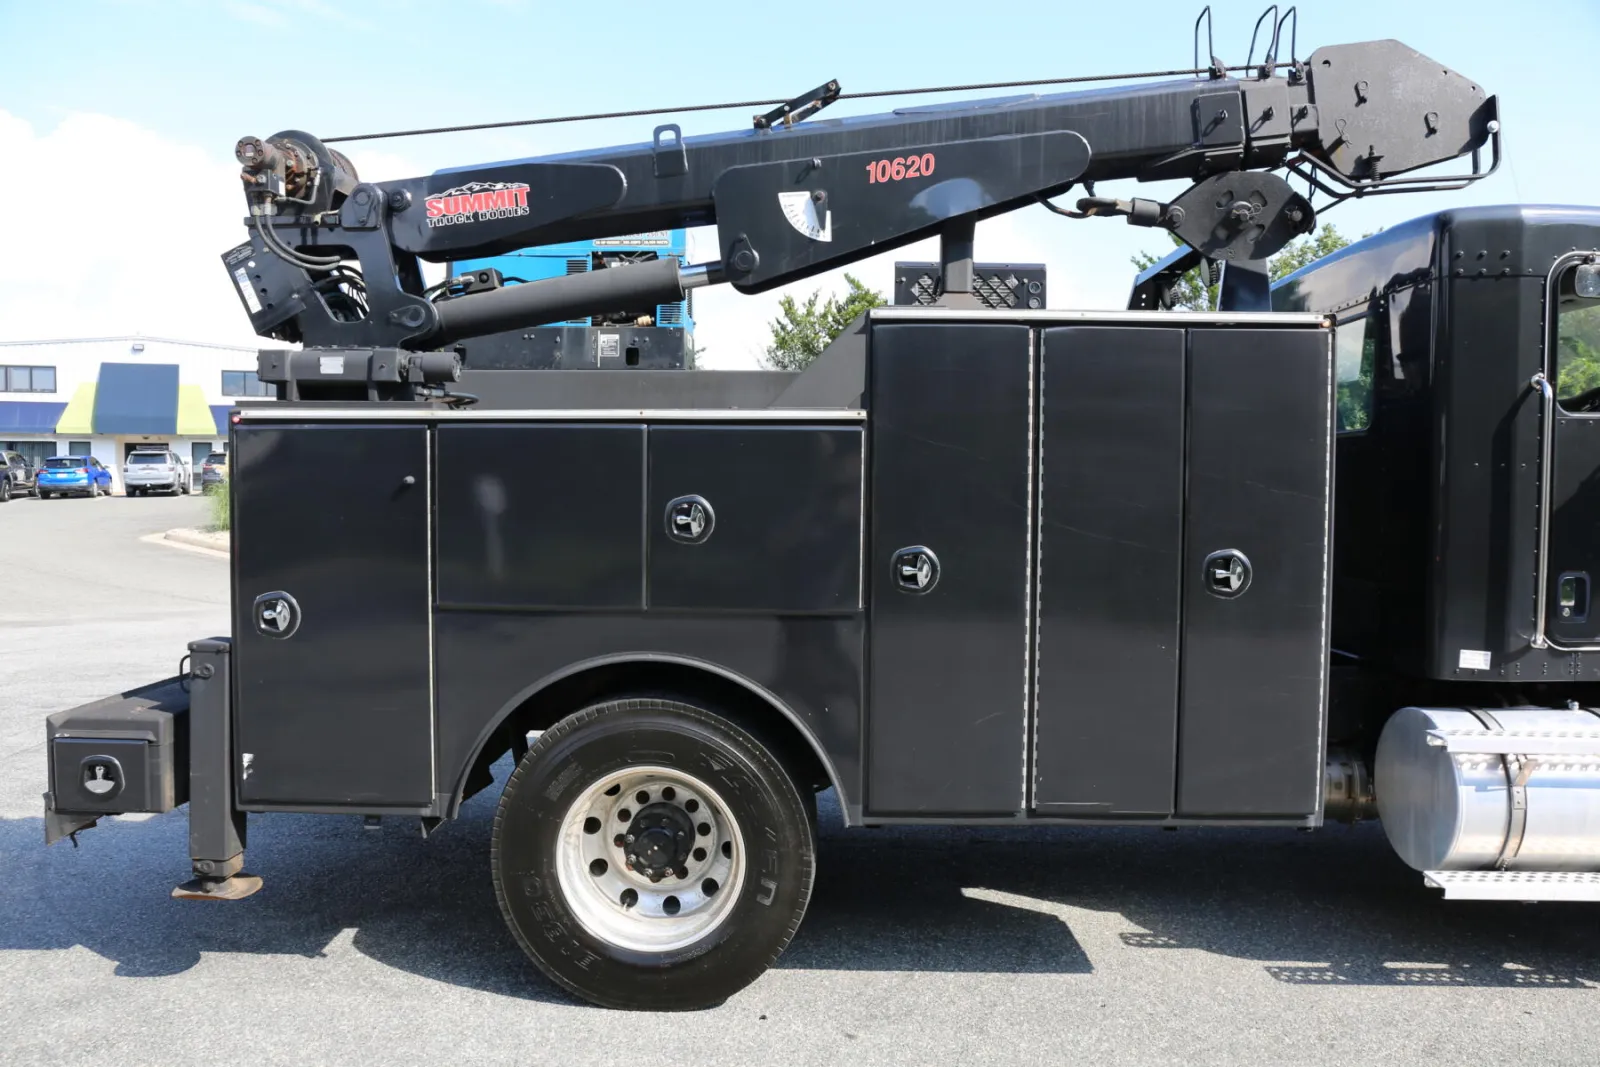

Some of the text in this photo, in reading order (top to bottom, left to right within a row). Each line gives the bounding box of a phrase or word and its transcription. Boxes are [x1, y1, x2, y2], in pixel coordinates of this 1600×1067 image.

[866, 153, 935, 184] 10620
[426, 187, 530, 217] SUMMIT
[427, 206, 530, 227] TRUCK BODIES
